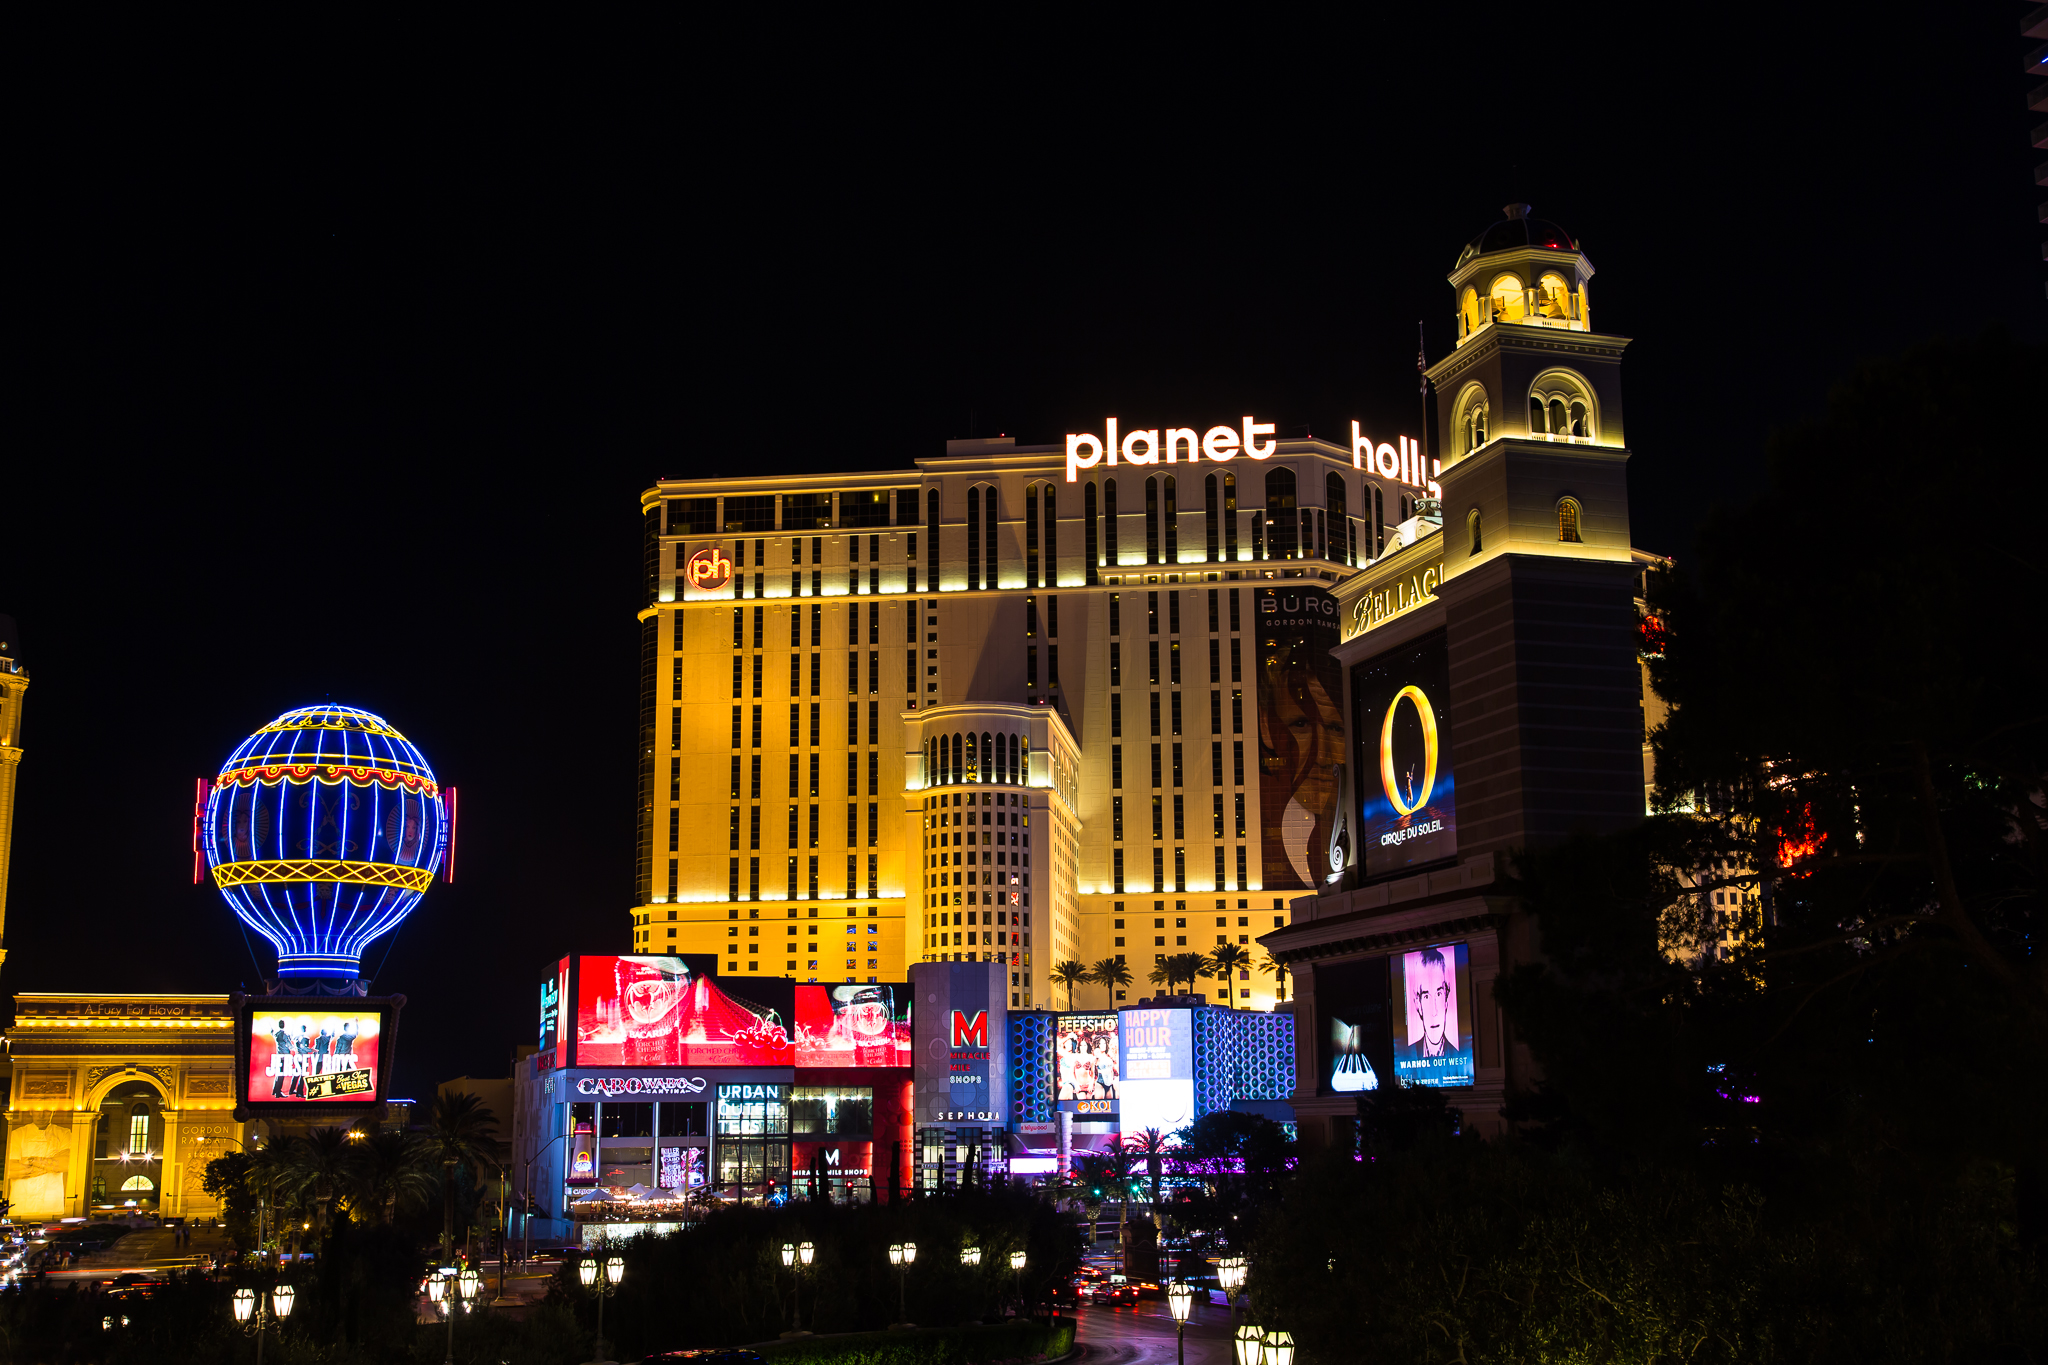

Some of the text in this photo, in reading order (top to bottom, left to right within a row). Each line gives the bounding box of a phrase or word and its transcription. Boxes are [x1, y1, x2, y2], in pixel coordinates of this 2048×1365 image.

[1065, 415, 1277, 482] planet
[692, 548, 731, 585] ph
[1266, 618, 1313, 627] GORDON
[1380, 685, 1438, 815] O
[1381, 819, 1443, 846] CIRQUE DU SOLEIL
[84, 1003, 185, 1016] A Fury For Flavor
[1125, 1010, 1172, 1027] HAPPY
[951, 1009, 988, 1048] M
[1125, 1026, 1172, 1047] HOUR
[950, 1052, 991, 1060] MIRACLE
[1400, 1056, 1468, 1069] WARHOL OUT WEST
[265, 1053, 359, 1077] JERSEY BOYS
[950, 1064, 971, 1072] MILE
[307, 1074, 336, 1084] RATED
[341, 1079, 369, 1091] VEGAS
[949, 1075, 982, 1084] SHOPS
[576, 1077, 643, 1098] CABO
[641, 1077, 692, 1093] WABO
[718, 1084, 779, 1099] URBAN
[718, 1102, 781, 1117] OUTFIT
[1089, 1100, 1112, 1110] KOI
[938, 1111, 1000, 1121] SEPHORA
[182, 1125, 229, 1135] GORDON
[844, 1168, 868, 1176] SHOPS
